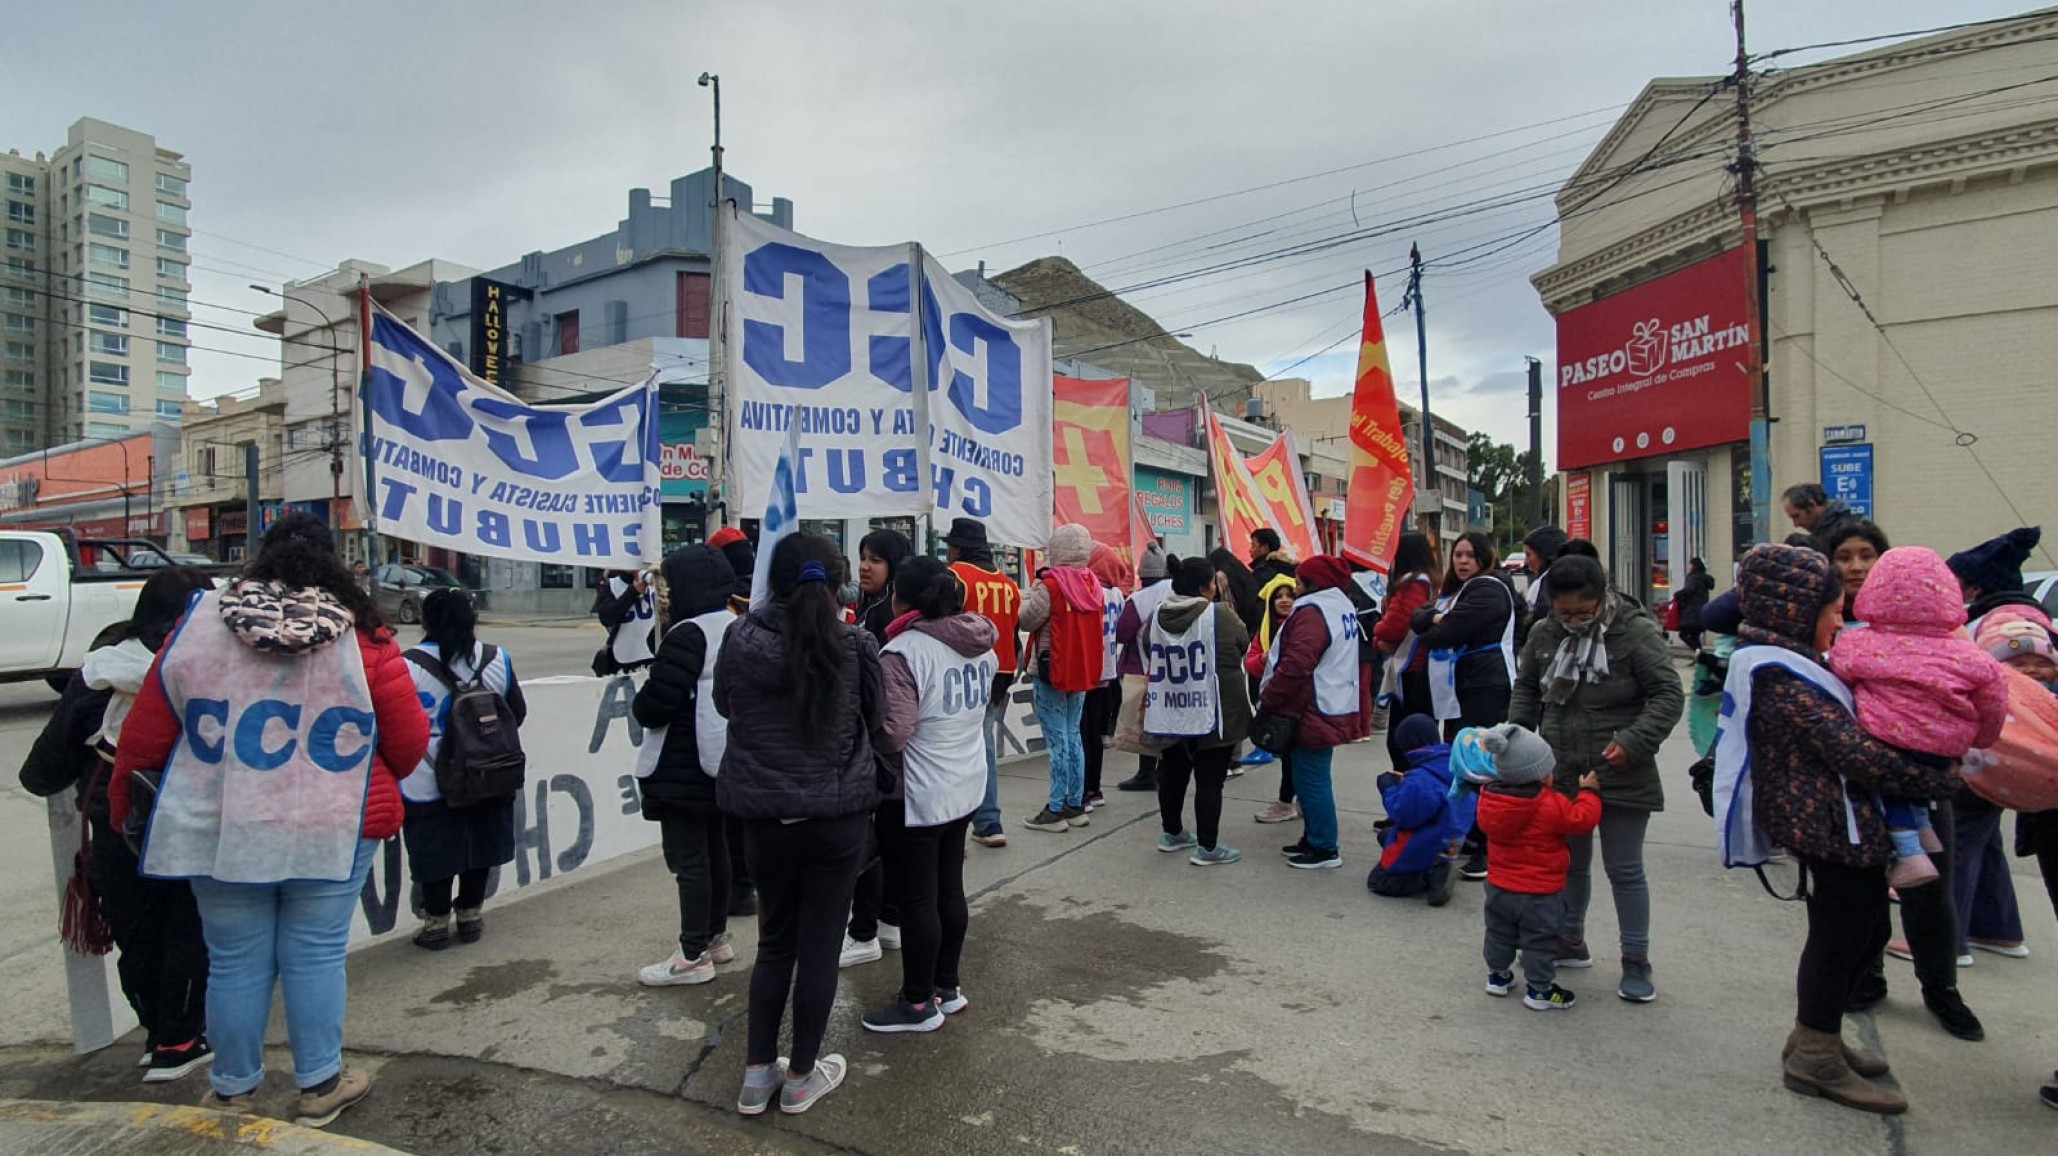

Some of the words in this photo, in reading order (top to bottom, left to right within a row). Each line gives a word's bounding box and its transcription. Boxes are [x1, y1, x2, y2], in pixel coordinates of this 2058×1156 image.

[1671, 315, 1710, 344] SAN
[1561, 350, 1626, 387] PASEO
[1617, 377, 1652, 395] Integral
[1655, 374, 1667, 385] de
[1669, 361, 1716, 381] Compras
[1362, 419, 1409, 464] Trabajo
[662, 463, 682, 476] de
[975, 582, 1014, 615] PTP
[1150, 640, 1207, 684] CCC
[943, 660, 991, 715] CCC
[184, 698, 375, 773] CCC
